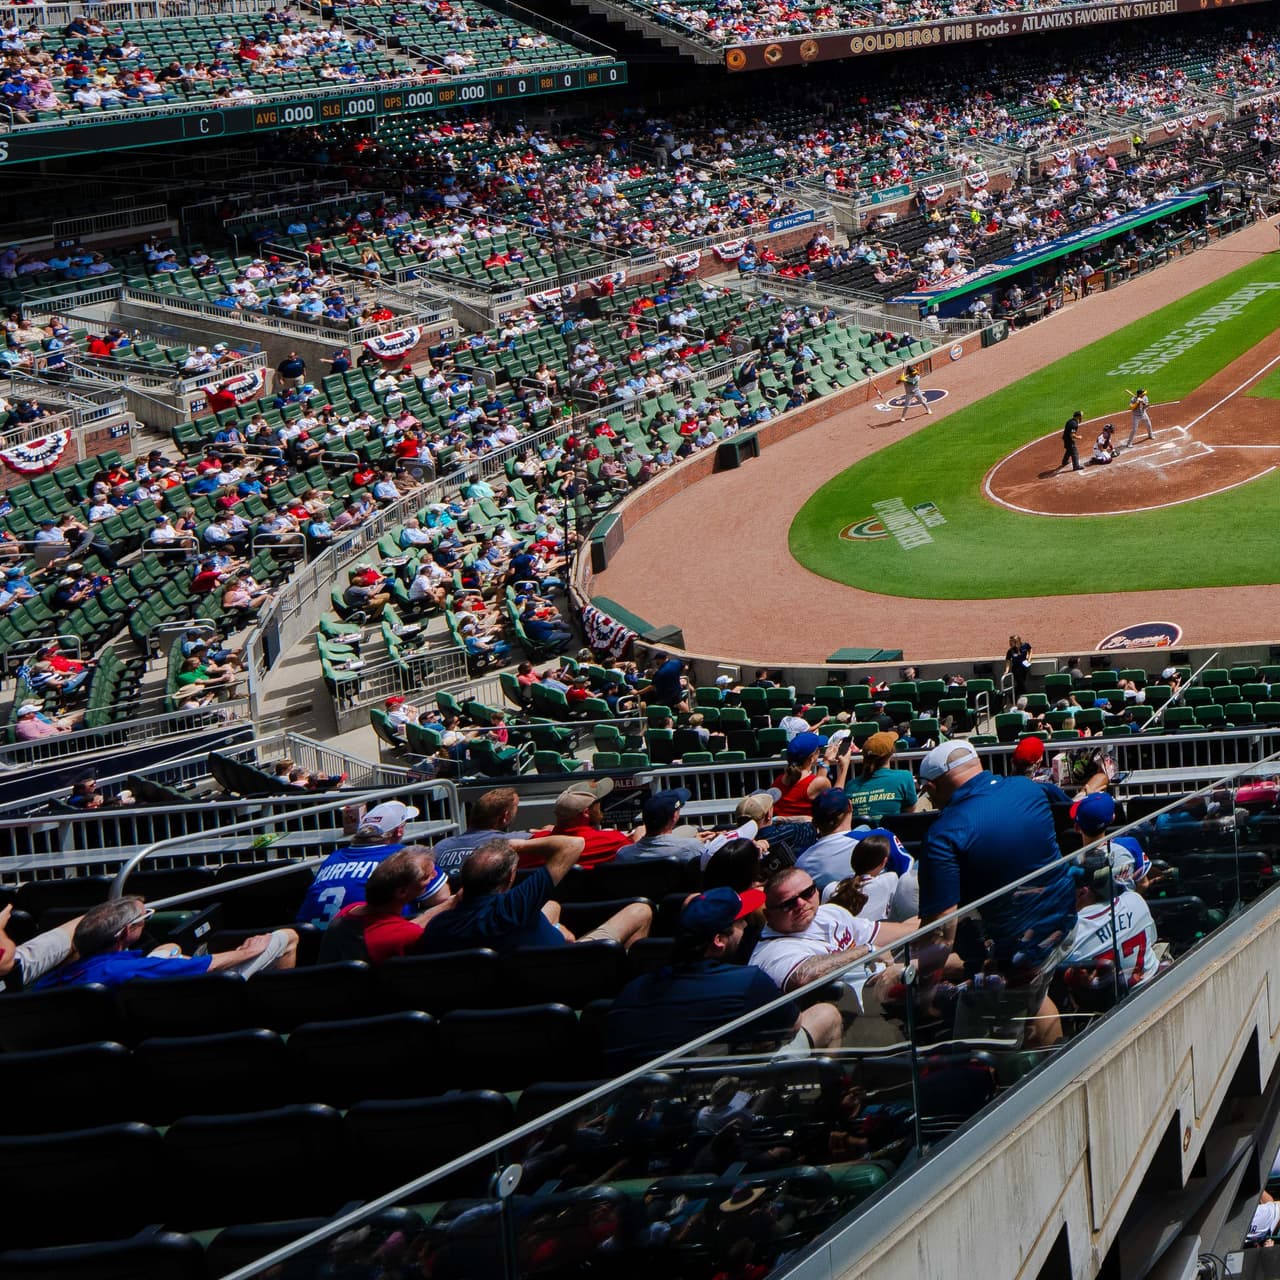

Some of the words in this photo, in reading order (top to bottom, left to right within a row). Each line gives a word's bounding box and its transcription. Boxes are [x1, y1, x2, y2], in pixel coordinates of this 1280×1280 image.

[1022, 12, 1072, 32] ATLANTA'S
[1075, 6, 1118, 25] FAVORITE
[1120, 5, 1132, 18] NY
[1134, 3, 1158, 17] STYLE
[1160, 0, 1178, 14] DELI
[851, 27, 940, 53] GOLDBERGS
[944, 24, 972, 41] FINE
[976, 20, 1009, 37] Foods
[256, 111, 276, 124] AVG
[281, 106, 313, 122] .000
[322, 104, 340, 117] SLG
[345, 98, 375, 115] .000
[384, 97, 401, 109] OPS
[405, 91, 433, 107] .000
[439, 90, 455, 102] OBP
[459, 85, 484, 100] .000
